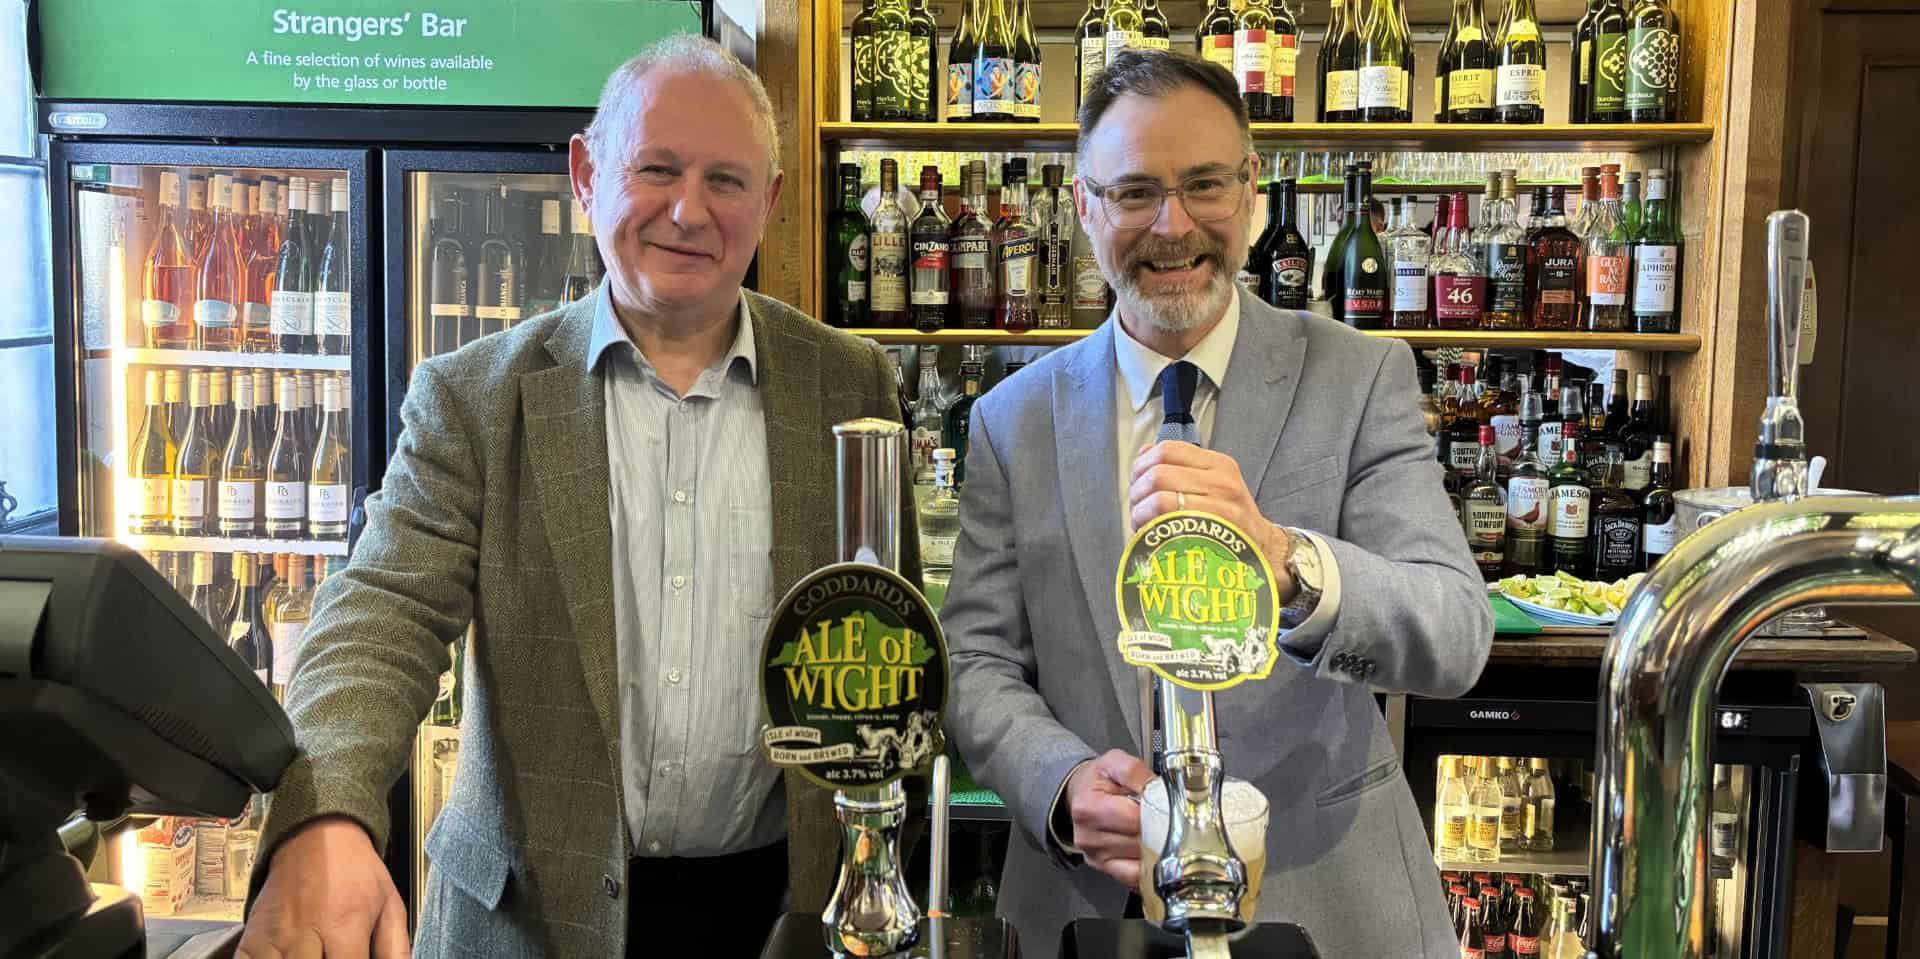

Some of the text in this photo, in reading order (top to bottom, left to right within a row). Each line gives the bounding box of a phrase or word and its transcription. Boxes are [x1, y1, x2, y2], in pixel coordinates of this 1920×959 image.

[273, 9, 467, 41] Strangers' Bar
[246, 51, 493, 70] A fine selection of wines available
[293, 73, 447, 92] by the glass or bottle
[913, 241, 949, 252] CINZANO
[1002, 241, 1035, 259] APEROL
[1545, 258, 1574, 266] JURA
[1447, 287, 1473, 304] 46
[1144, 518, 1247, 553] GODDARDS
[1144, 549, 1249, 590] ALE of
[793, 575, 917, 617] GODDARDS
[1136, 583, 1256, 624] WIGHT
[792, 616, 917, 666] ALE of
[783, 665, 924, 712] WIGHT
[1470, 710, 1510, 720] GAMKO
[773, 750, 797, 761] BORN
[814, 745, 849, 760] BREWED
[826, 768, 884, 779] alc 3.7% vol
